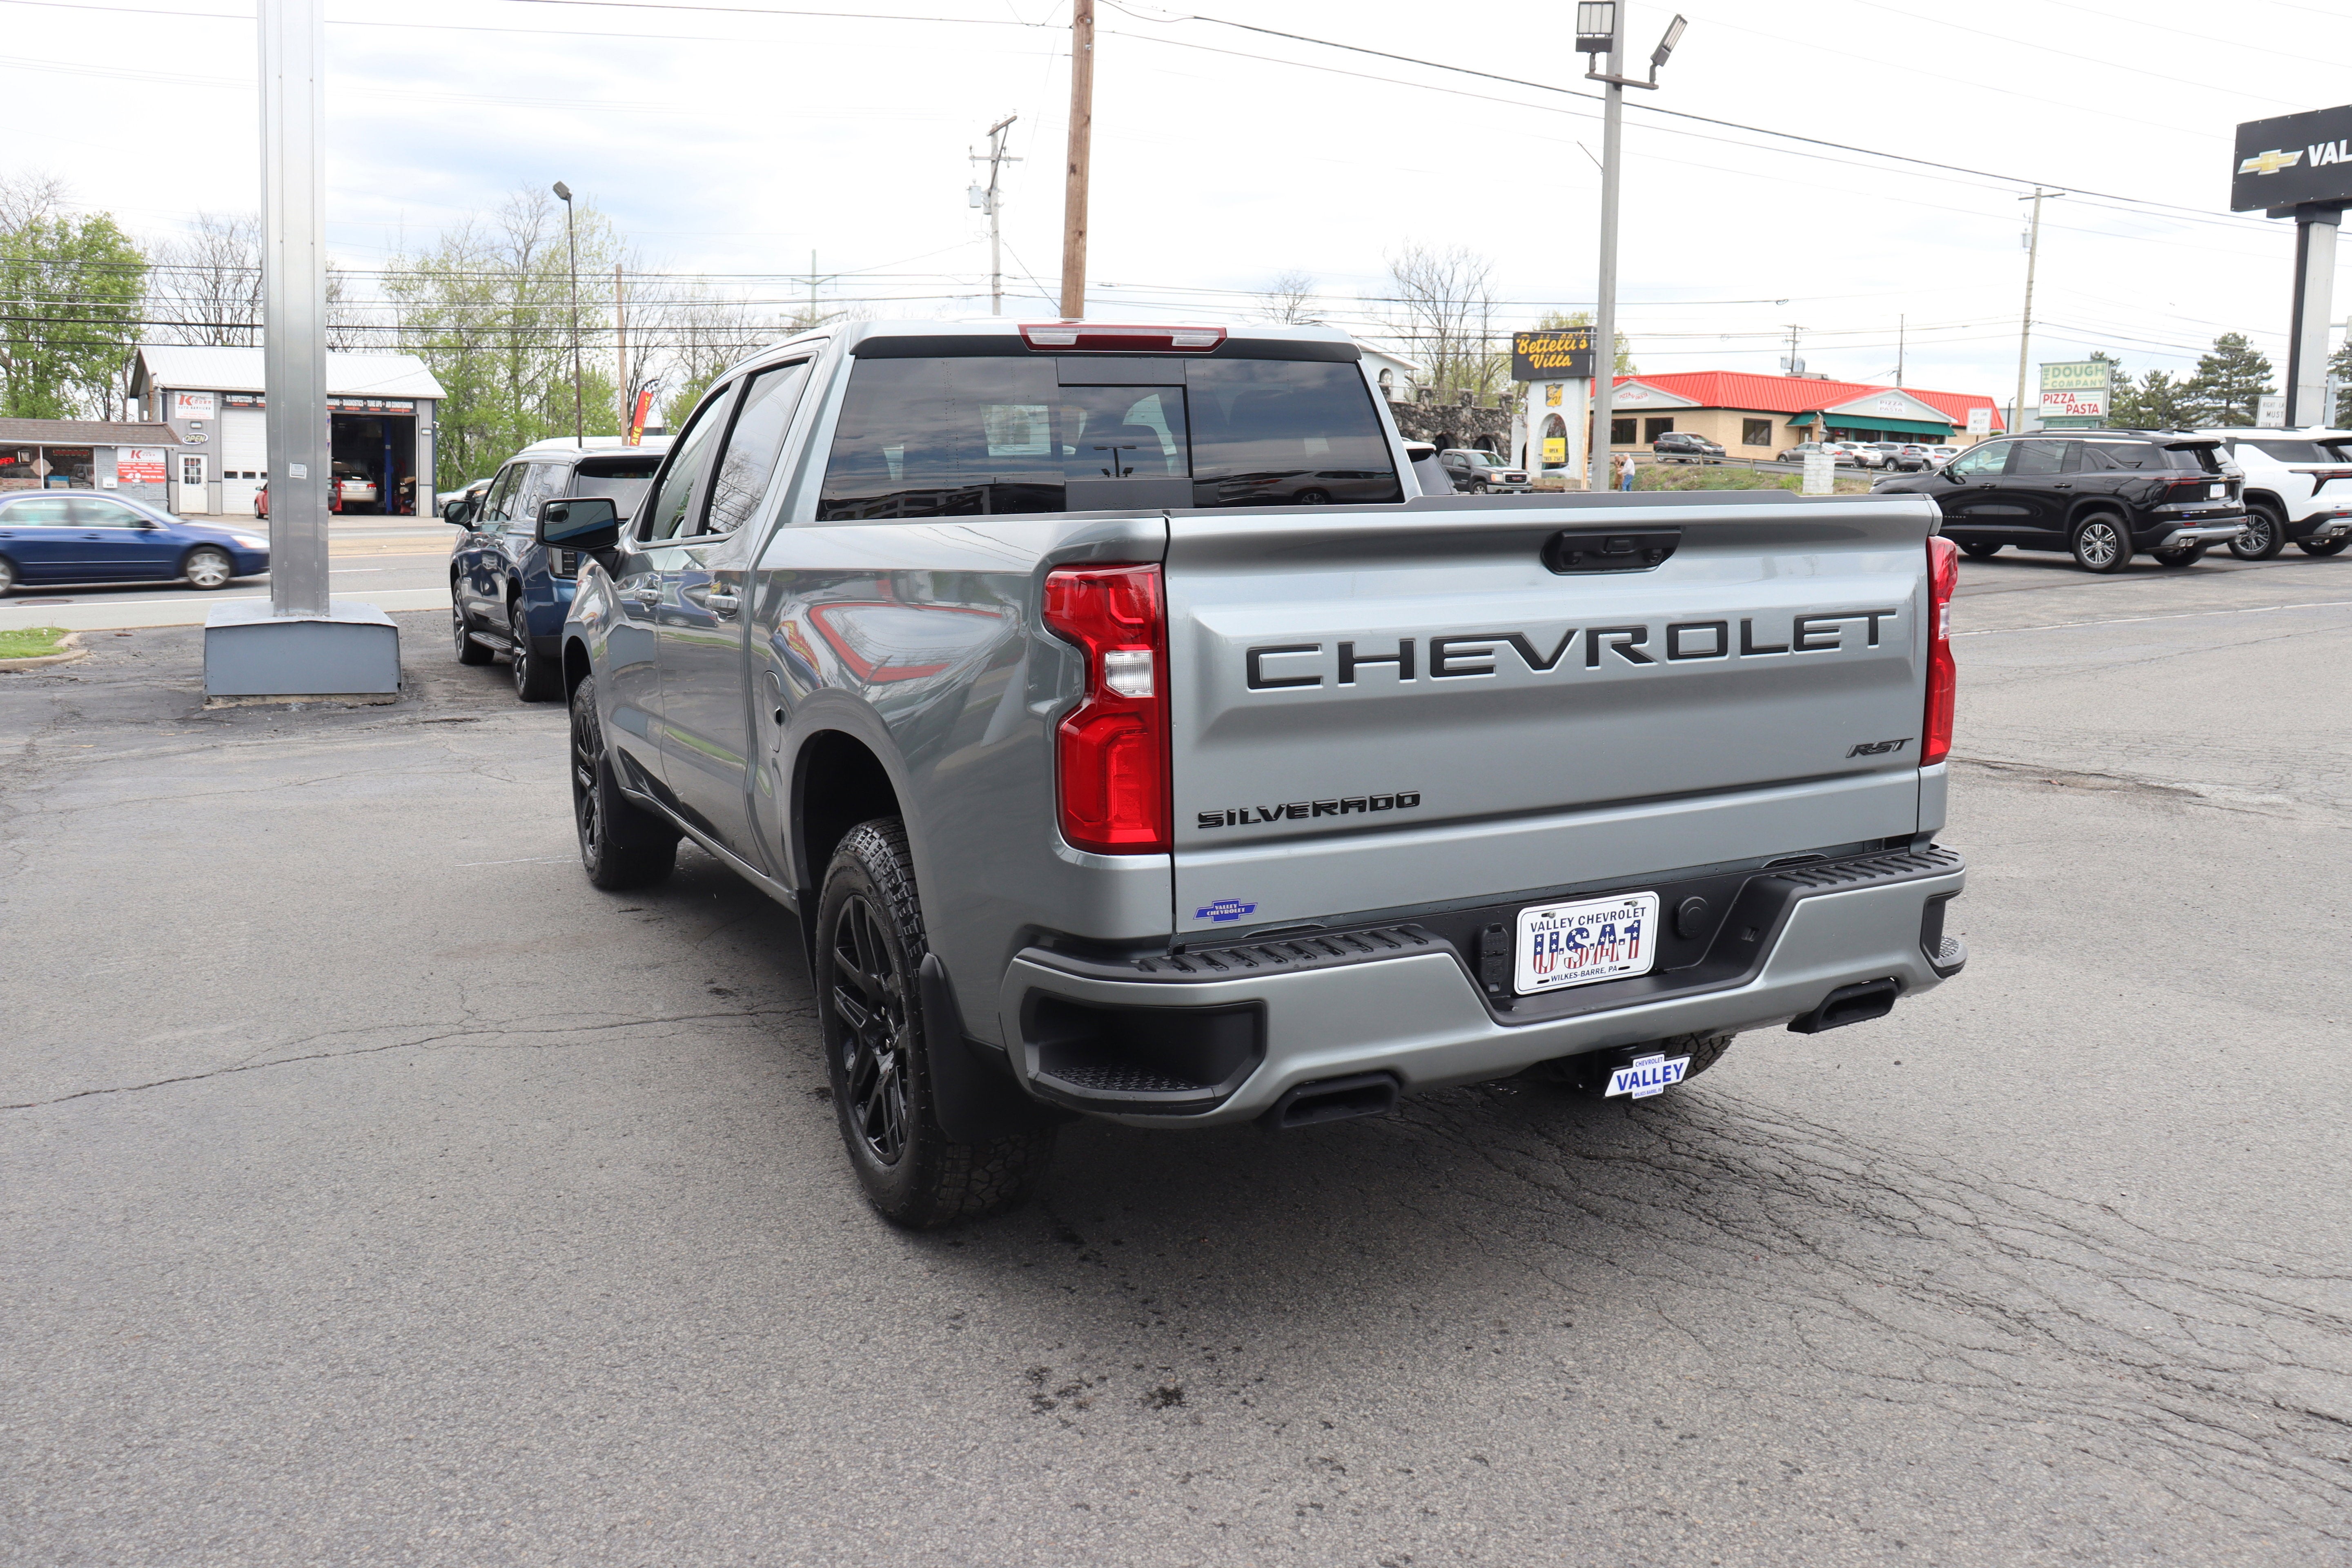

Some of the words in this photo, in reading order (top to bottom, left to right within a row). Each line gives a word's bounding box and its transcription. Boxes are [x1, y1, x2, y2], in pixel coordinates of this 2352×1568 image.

[1516, 329, 1588, 354] Bettelli's
[1529, 352, 1572, 369] Villa
[2052, 365, 2105, 378] DOUGH
[2051, 379, 2104, 388] COMPANY
[2043, 393, 2075, 404] PIZZA
[2066, 403, 2099, 414] PASTA
[1246, 609, 1898, 691] CHEVROLET
[1846, 737, 1914, 758] RST
[1198, 790, 1421, 829] SILVERADO
[1207, 907, 1245, 916] CHEVROLET
[1530, 917, 1574, 933] VALLEY
[1578, 907, 1646, 926] CHEVROLET
[1551, 967, 1606, 982] WILKES-BARRE,
[1635, 1057, 1663, 1067] CHEVROLET
[1616, 1062, 1684, 1091] VALLEY
